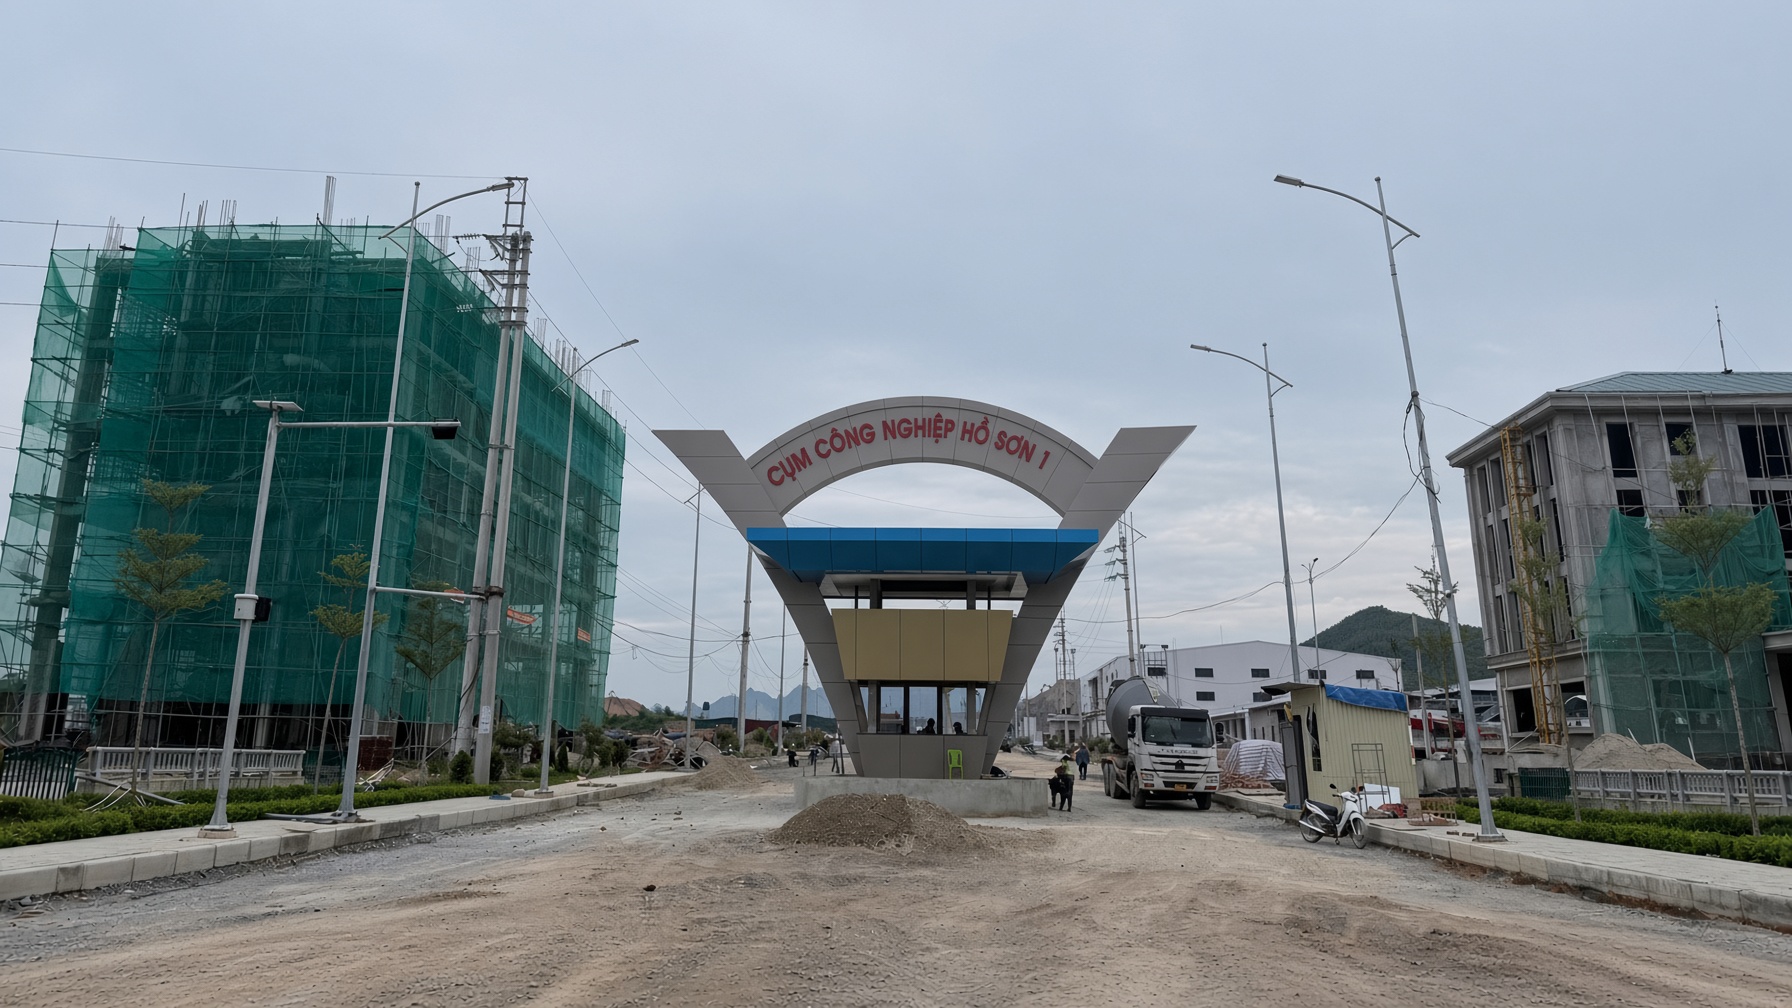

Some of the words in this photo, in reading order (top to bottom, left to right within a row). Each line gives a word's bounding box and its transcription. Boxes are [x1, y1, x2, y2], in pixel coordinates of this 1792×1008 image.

[767, 447, 813, 486] CỤM
[815, 423, 876, 459] CÔNG
[882, 412, 955, 443] NGHIỆP
[960, 416, 990, 445] HỒ
[994, 430, 1037, 462] SƠN
[1039, 450, 1051, 470] 1
